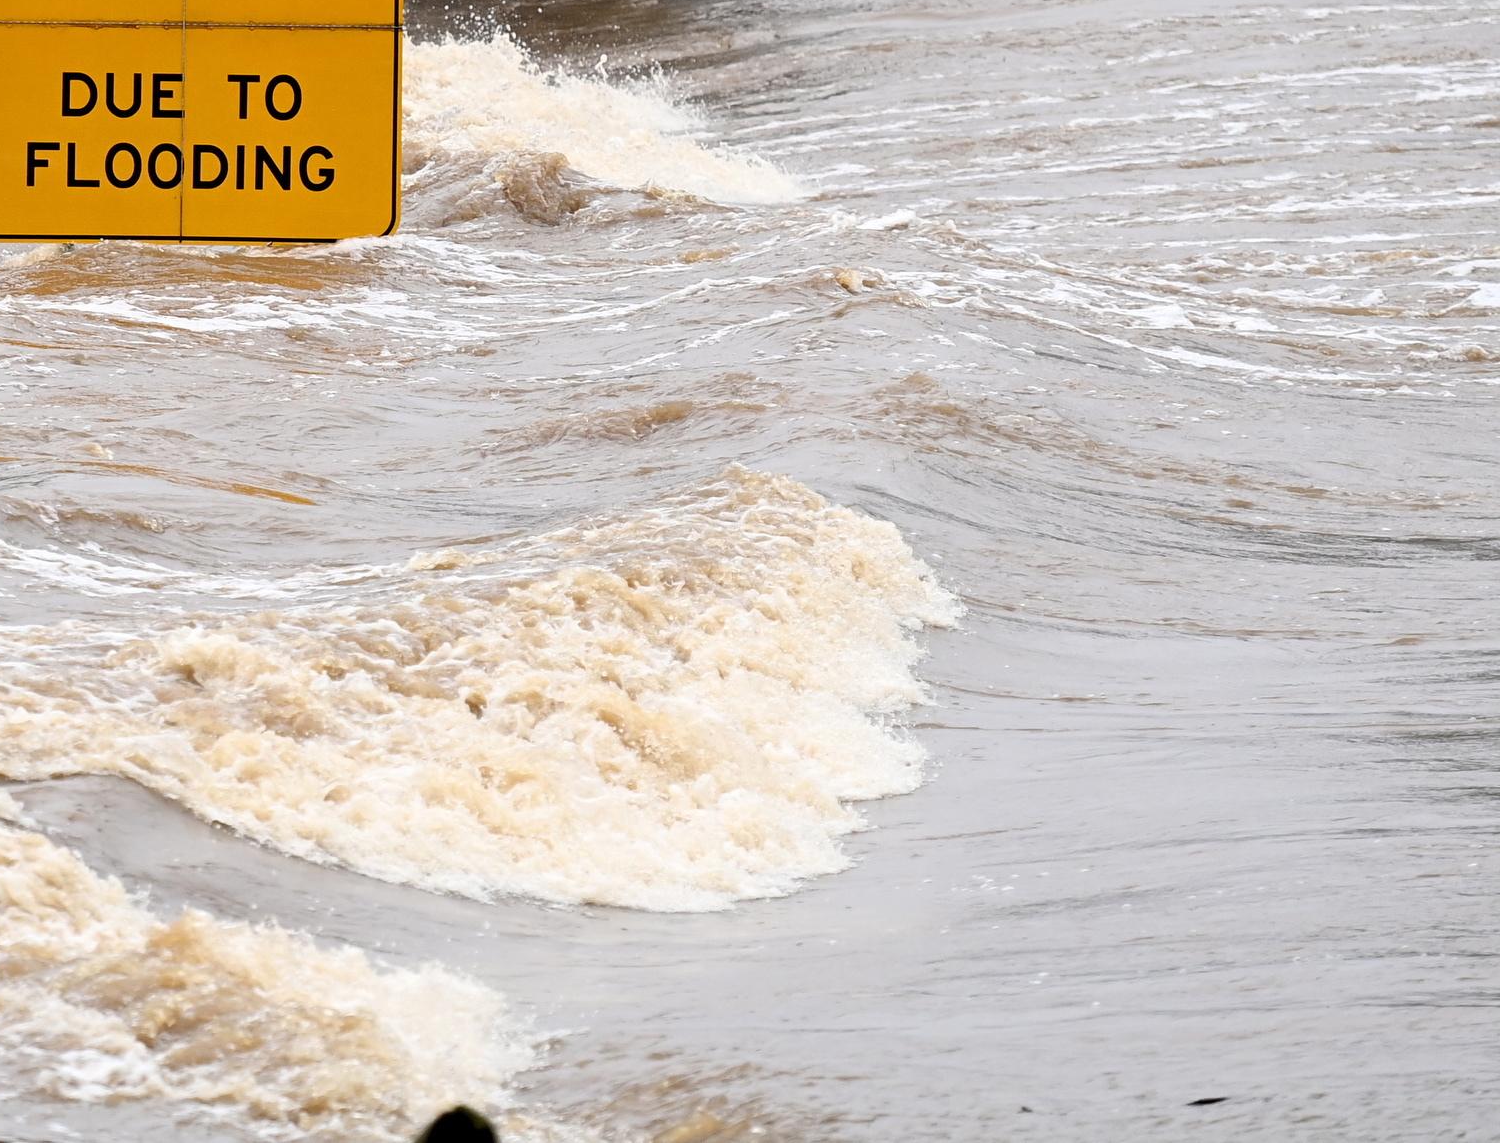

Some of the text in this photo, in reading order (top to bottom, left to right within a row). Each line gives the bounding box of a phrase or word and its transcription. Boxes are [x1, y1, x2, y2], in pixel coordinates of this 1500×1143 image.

[61, 71, 303, 121] DUE TO
[26, 141, 335, 192] FLOODING
